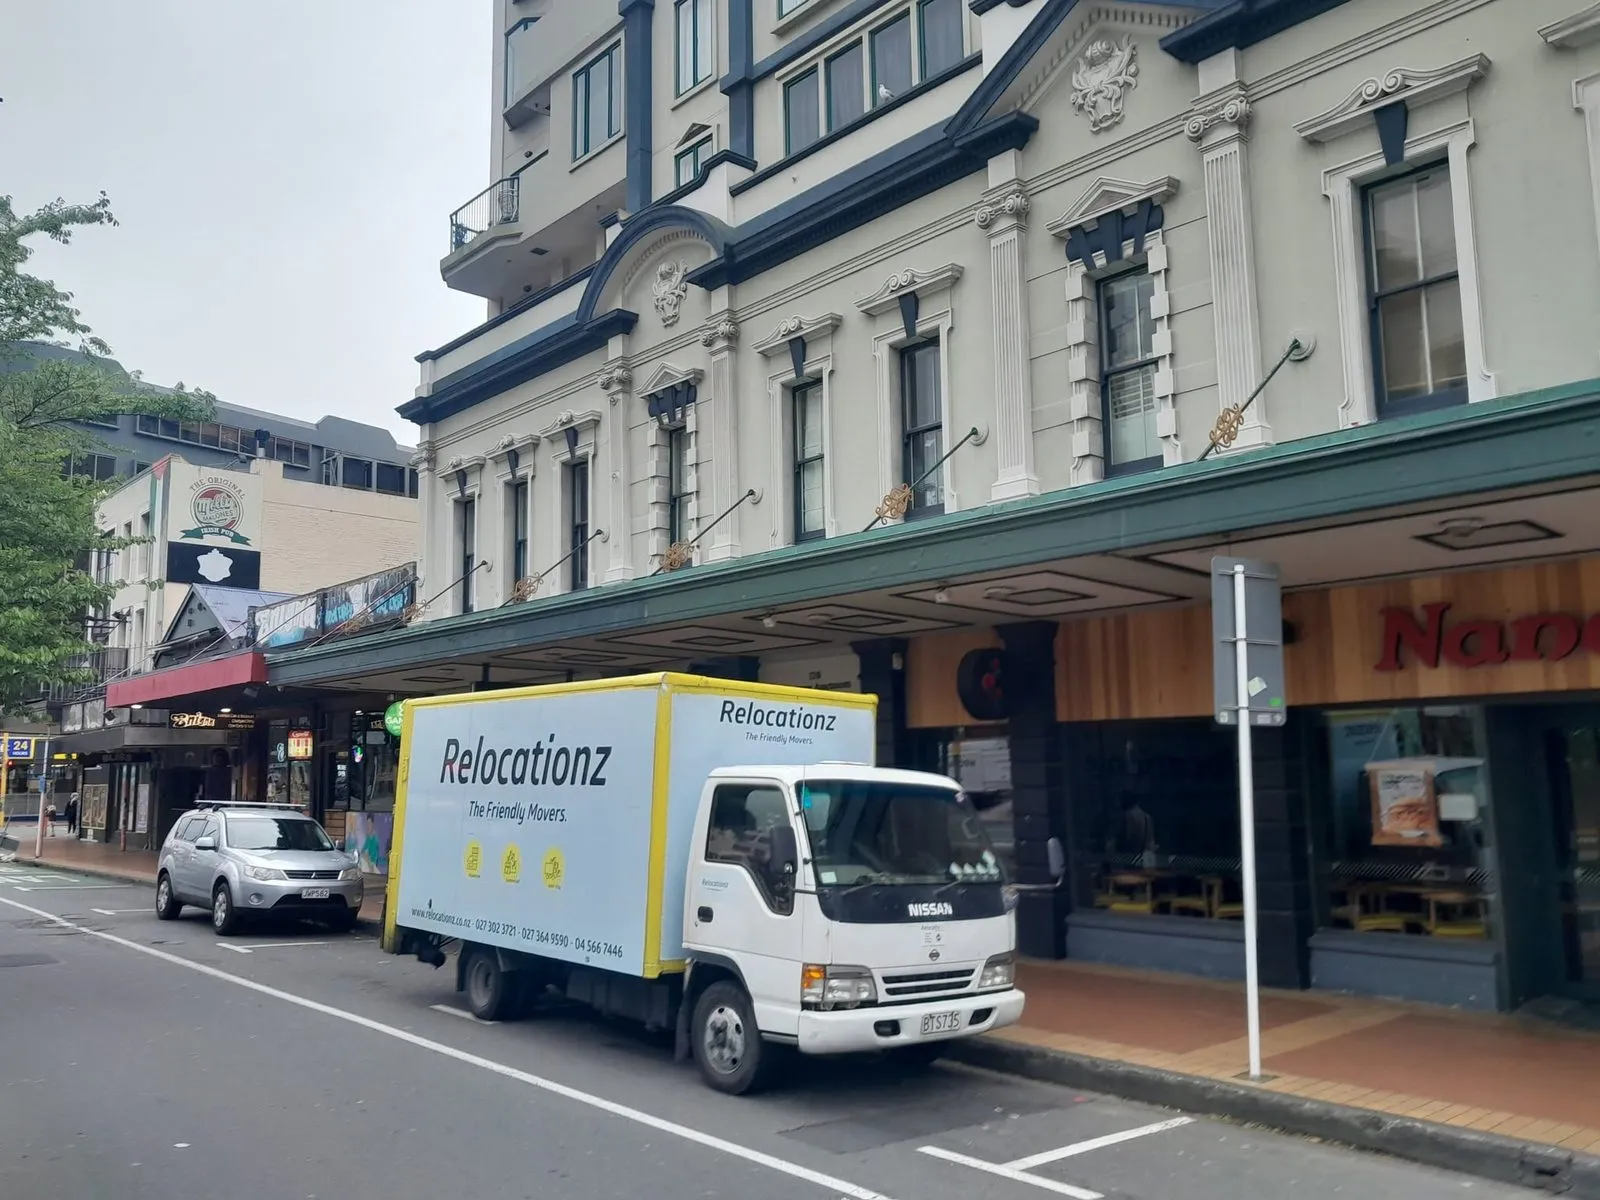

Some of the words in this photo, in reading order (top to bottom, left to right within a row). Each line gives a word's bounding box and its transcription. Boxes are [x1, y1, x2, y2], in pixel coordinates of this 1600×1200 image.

[189, 478, 206, 492] THE
[208, 476, 247, 500] ORIGINAL
[220, 528, 235, 538] PUB
[720, 699, 837, 731] Relocationz
[13, 740, 29, 751] 24
[745, 731, 759, 741] The
[759, 732, 788, 746] Friendly
[440, 733, 613, 786] Relocationz
[469, 800, 485, 818] The
[485, 801, 526, 825] Friendly
[527, 802, 568, 822] Movers.
[907, 901, 953, 917] NISSAN
[475, 918, 487, 930] 027
[488, 920, 500, 934] 302
[501, 923, 517, 936] 3721
[521, 927, 535, 941] 027
[536, 930, 550, 943] 364
[550, 932, 569, 948] 9590
[575, 937, 585, 950] 04
[586, 939, 601, 954] 566
[603, 942, 623, 958] 7446
[923, 1011, 960, 1031] BTS735
